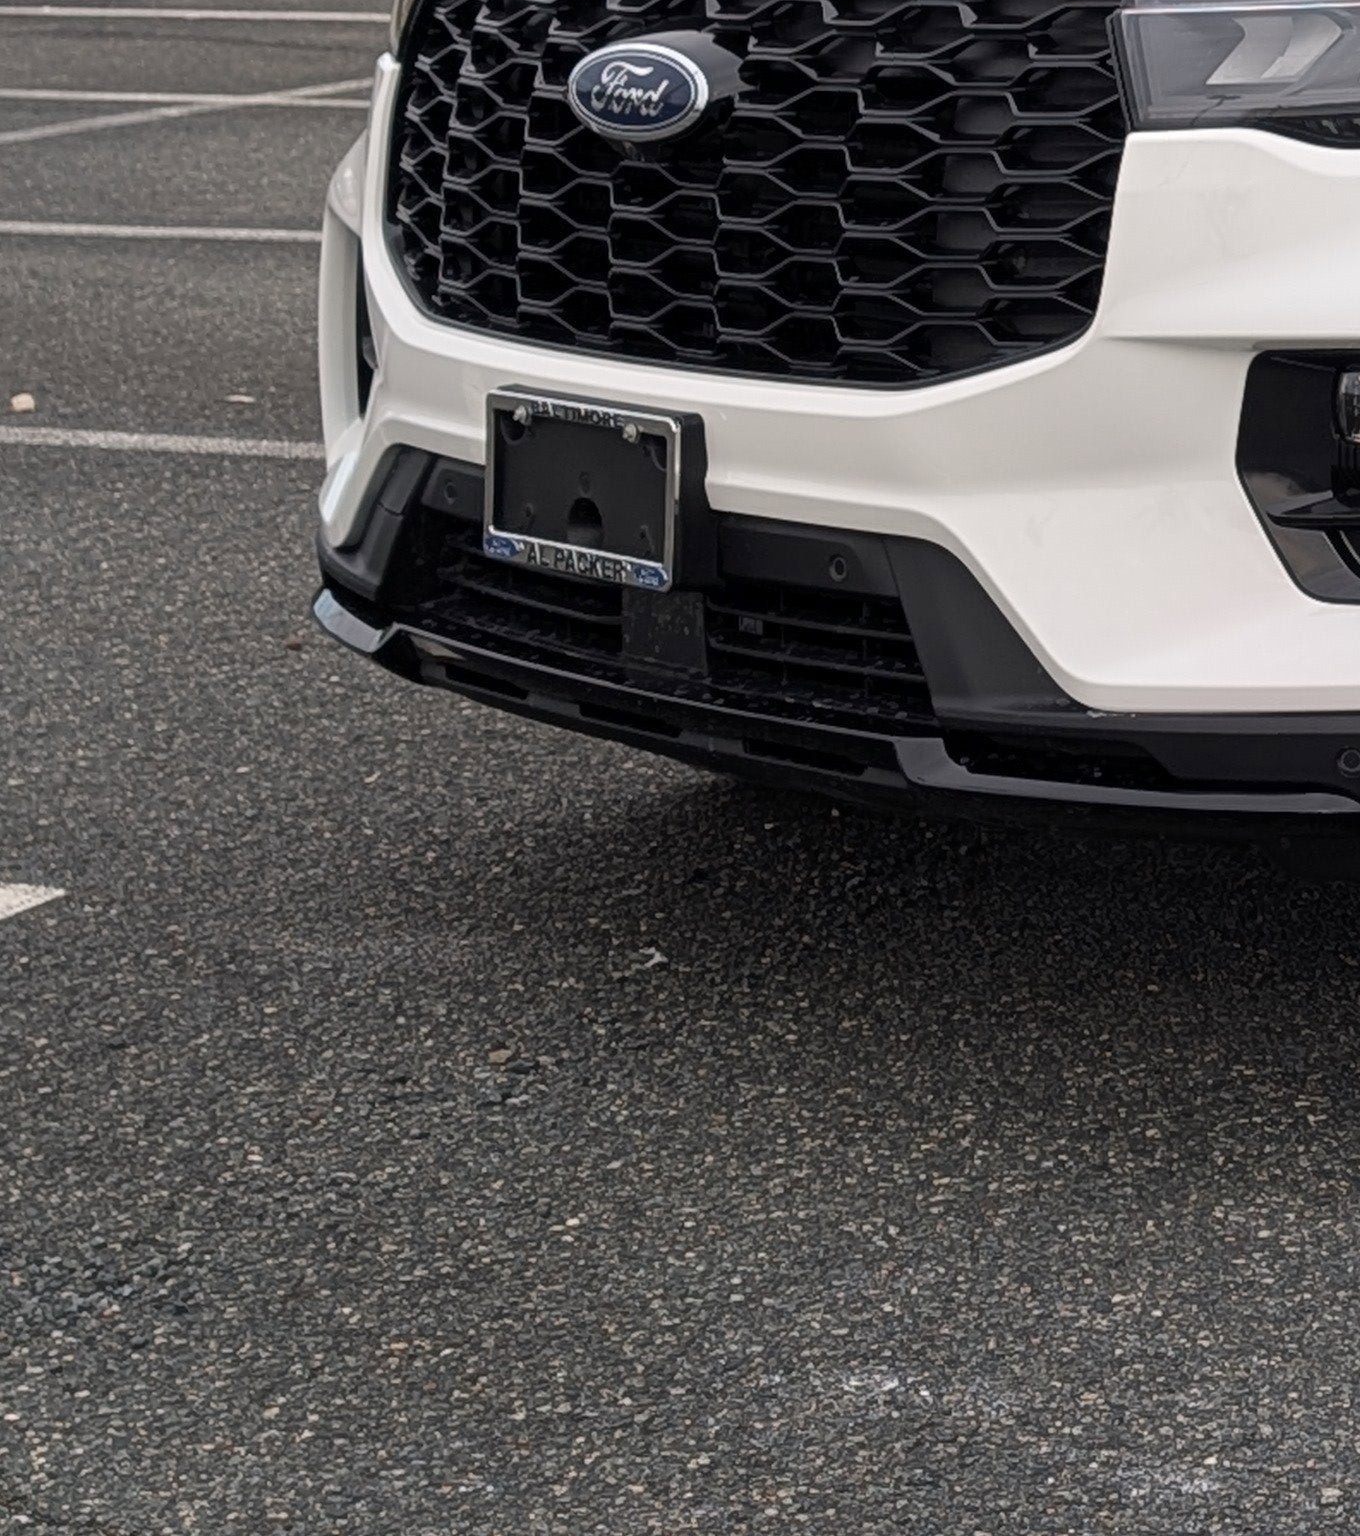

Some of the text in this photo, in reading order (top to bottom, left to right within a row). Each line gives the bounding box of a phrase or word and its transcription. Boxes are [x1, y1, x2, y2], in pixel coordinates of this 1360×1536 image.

[590, 61, 668, 119] Ford
[531, 400, 624, 428] BALTIMORE
[527, 543, 550, 566] AL
[554, 549, 626, 582] PACKER
